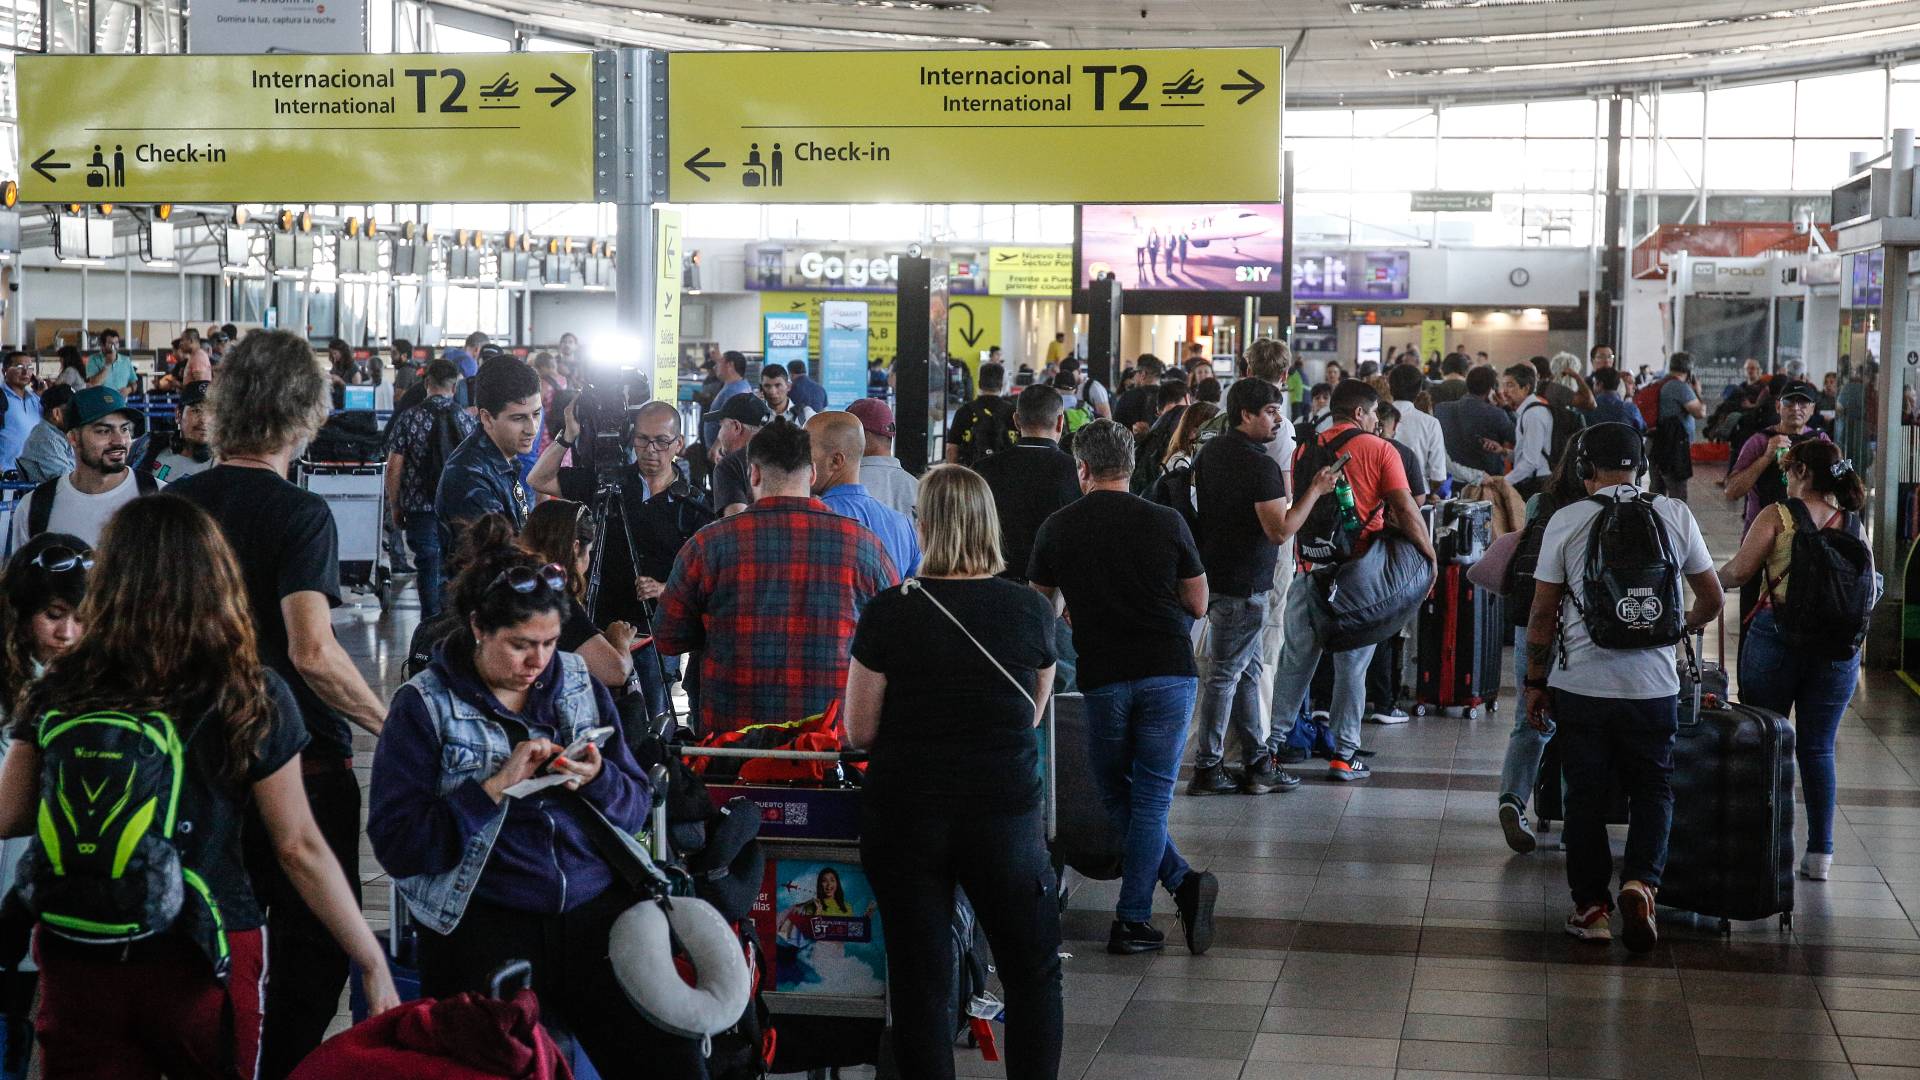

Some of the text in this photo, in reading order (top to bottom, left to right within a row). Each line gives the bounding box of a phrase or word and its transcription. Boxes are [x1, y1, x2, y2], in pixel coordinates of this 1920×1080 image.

[217, 15, 336, 25] Domina la luz, captura la noche
[252, 68, 394, 89] Internacional
[920, 64, 1071, 86] Internacional
[404, 68, 468, 113] T2
[1082, 64, 1149, 111] T2
[275, 96, 395, 114] International
[943, 93, 1071, 112] International
[135, 143, 226, 163] Check-in
[794, 141, 890, 161] Check-in
[801, 252, 844, 279] Go
[1324, 256, 1346, 287] it
[1718, 267, 1765, 276] POLO
[1302, 544, 1332, 558] PUMA
[1627, 588, 1654, 597] PUMA
